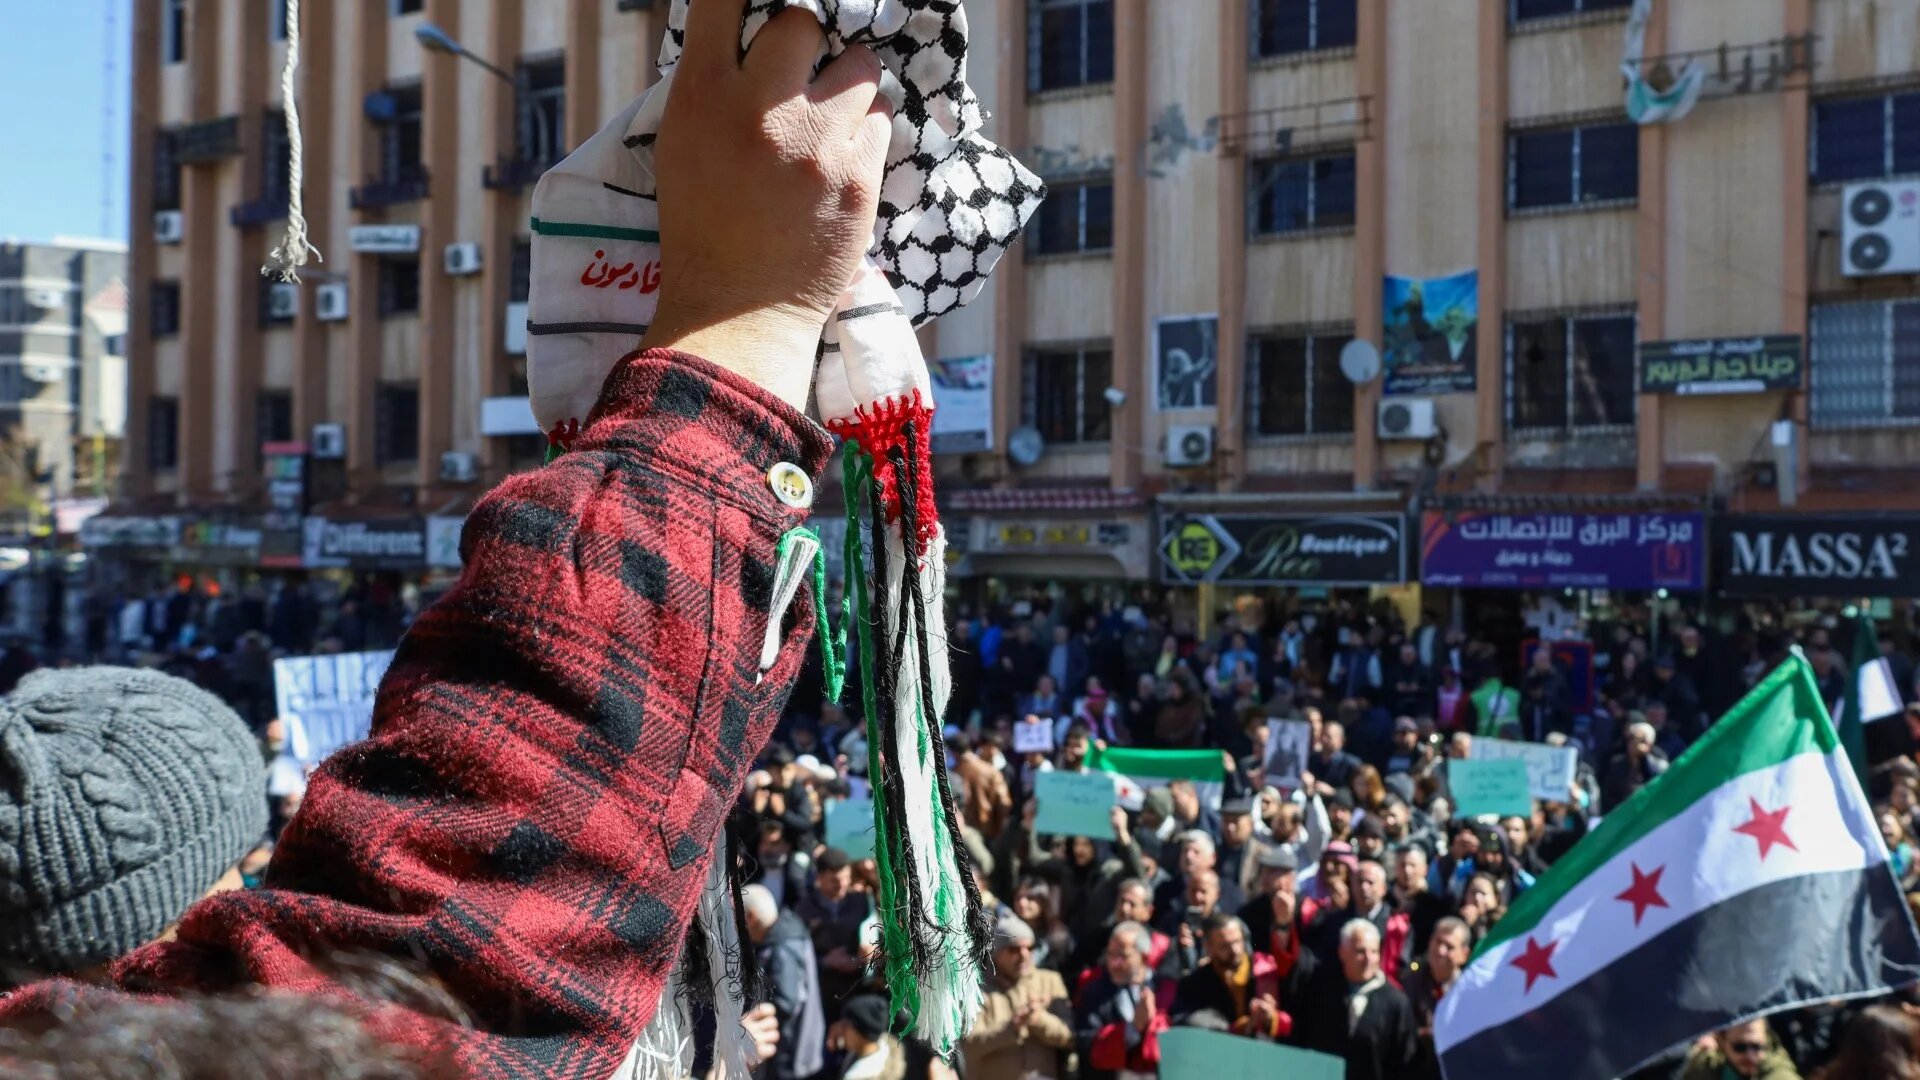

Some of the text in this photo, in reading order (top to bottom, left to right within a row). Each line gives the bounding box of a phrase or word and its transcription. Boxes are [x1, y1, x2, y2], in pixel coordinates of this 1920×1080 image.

[1579, 516, 1630, 545] البرق
[1636, 516, 1693, 544] مركز
[1300, 533, 1389, 558] Boutique
